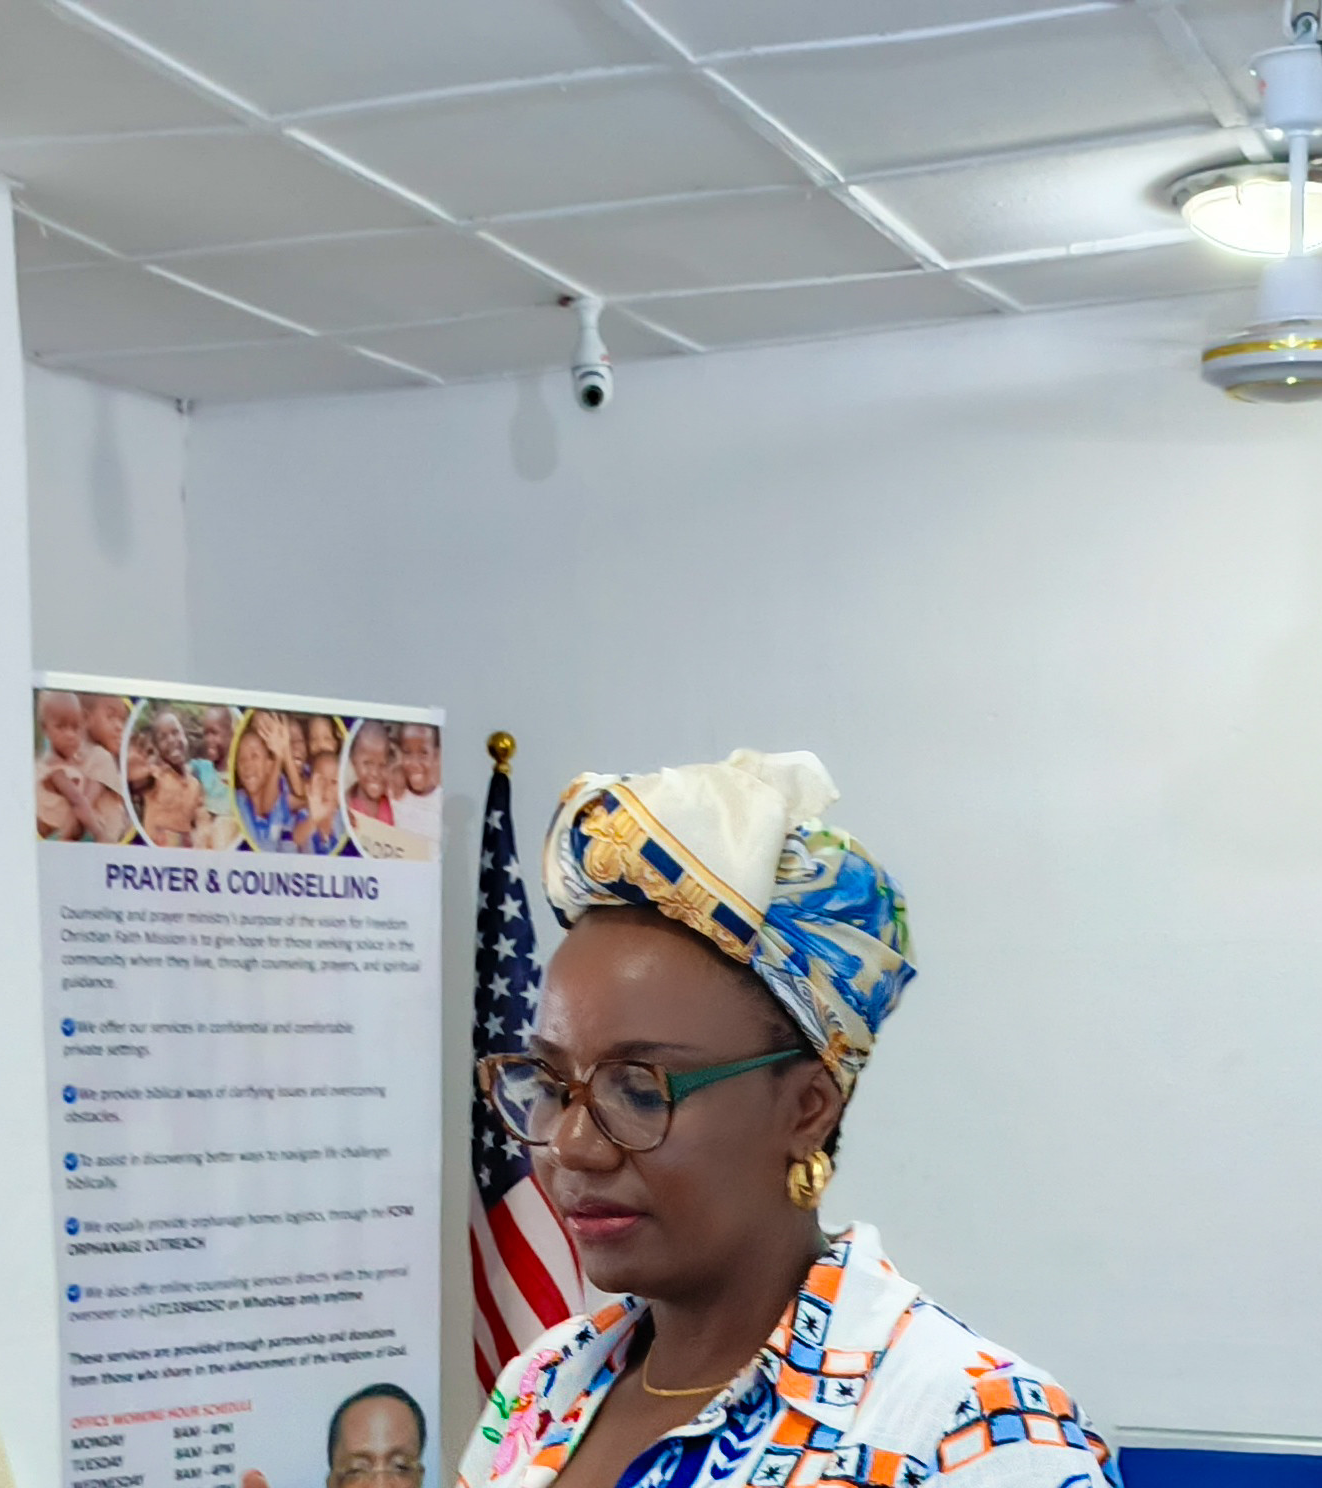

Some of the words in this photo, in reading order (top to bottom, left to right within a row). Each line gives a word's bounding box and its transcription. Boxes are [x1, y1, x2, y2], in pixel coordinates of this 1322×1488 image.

[106, 864, 199, 893] PRAYER
[207, 869, 221, 894] &
[228, 869, 379, 900] COUNSELLING
[71, 1435, 124, 1450] MONDAY
